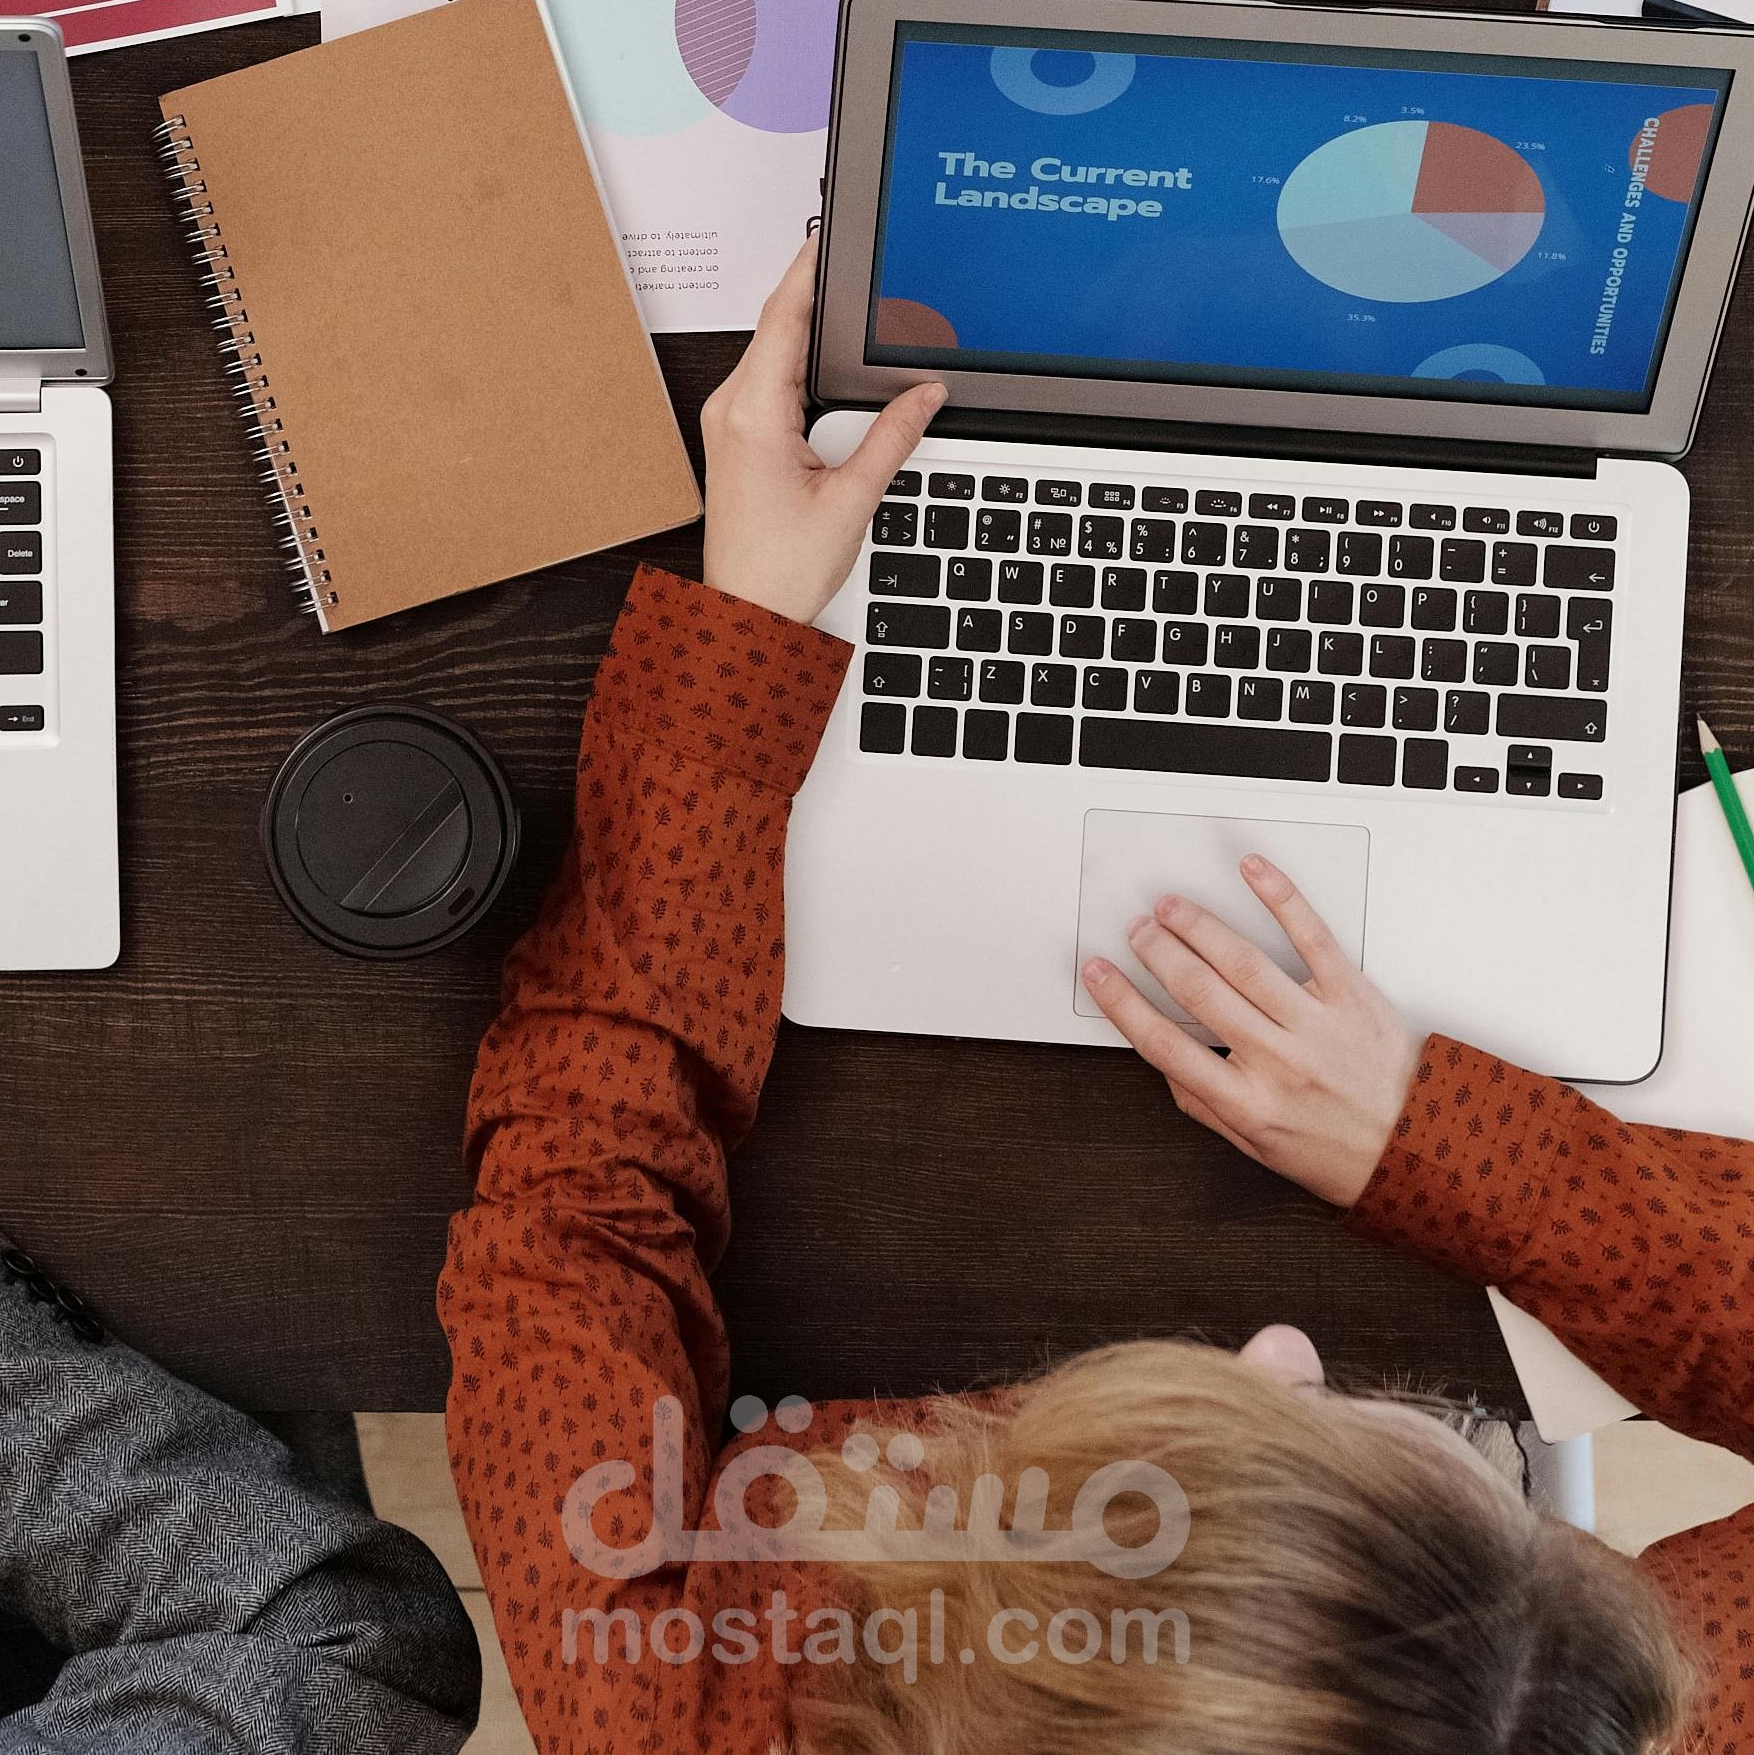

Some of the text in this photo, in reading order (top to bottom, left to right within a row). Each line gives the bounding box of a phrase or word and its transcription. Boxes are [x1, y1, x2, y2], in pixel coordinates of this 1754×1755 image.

[1344, 115, 1367, 123] 8.2%
[1515, 142, 1546, 153] 23.5%
[939, 152, 1192, 189] The Current
[1252, 176, 1280, 184] 17.6%
[935, 182, 1162, 221] Landscape
[1590, 118, 1659, 354] CHALLENGES AND OPPORTUNITIES
[1538, 252, 1566, 260] 11.8%
[638, 266, 657, 275] and
[679, 281, 719, 290] Content
[1347, 314, 1375, 322] 35.3%
[954, 563, 1427, 605] Q W E R T Y U O P
[963, 615, 1383, 653] A S D F G H J K L
